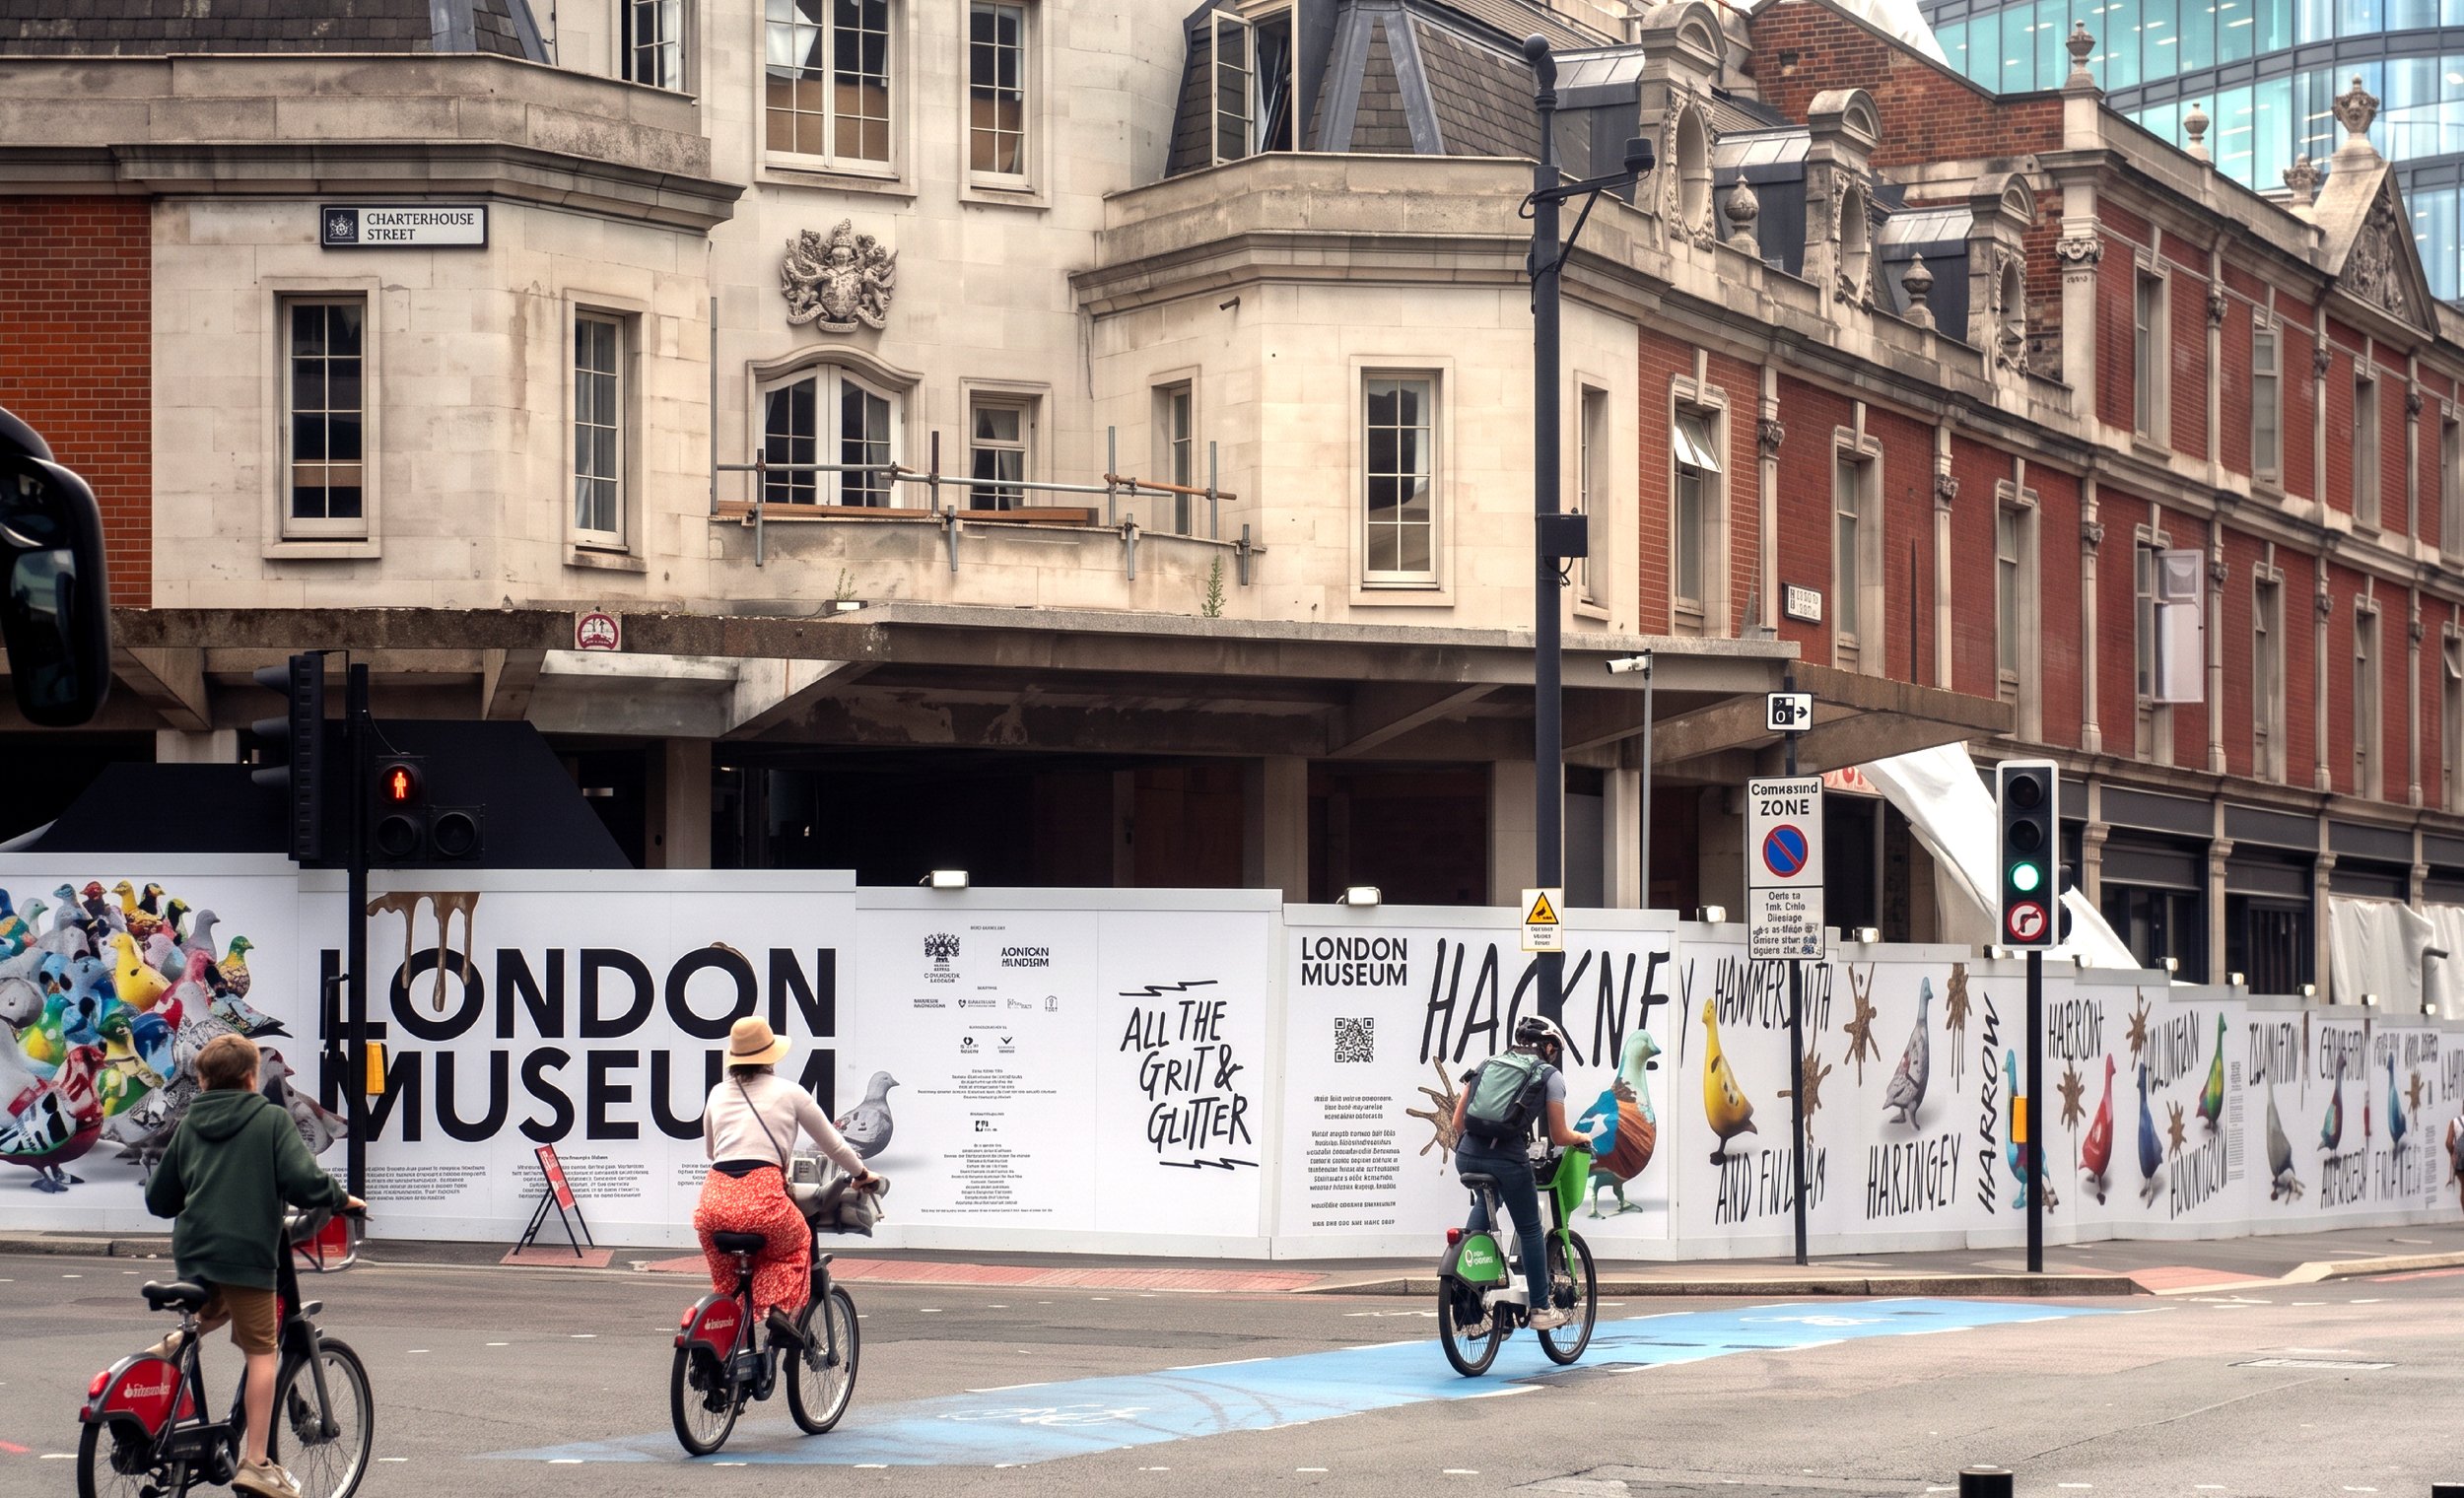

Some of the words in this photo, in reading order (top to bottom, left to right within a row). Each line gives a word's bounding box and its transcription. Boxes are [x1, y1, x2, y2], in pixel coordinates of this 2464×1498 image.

[367, 213, 474, 225] CHARTERHOUSE
[367, 229, 416, 240] STREET
[1760, 799, 1810, 816] ZONE
[1301, 963, 1407, 987] MUSEUM
[1302, 936, 1407, 961] LONDON
[319, 947, 836, 1041] LONDON
[1120, 1006, 1170, 1053] ALL
[1178, 1000, 1227, 1043] THE
[1139, 1046, 1215, 1102] GRIT
[1214, 1044, 1244, 1092] &
[1147, 1093, 1252, 1153] GLITTER
[1978, 991, 2000, 1214] HARROW
[1715, 1151, 1751, 1225] AND
[1867, 1132, 1961, 1220] HARINGEY
